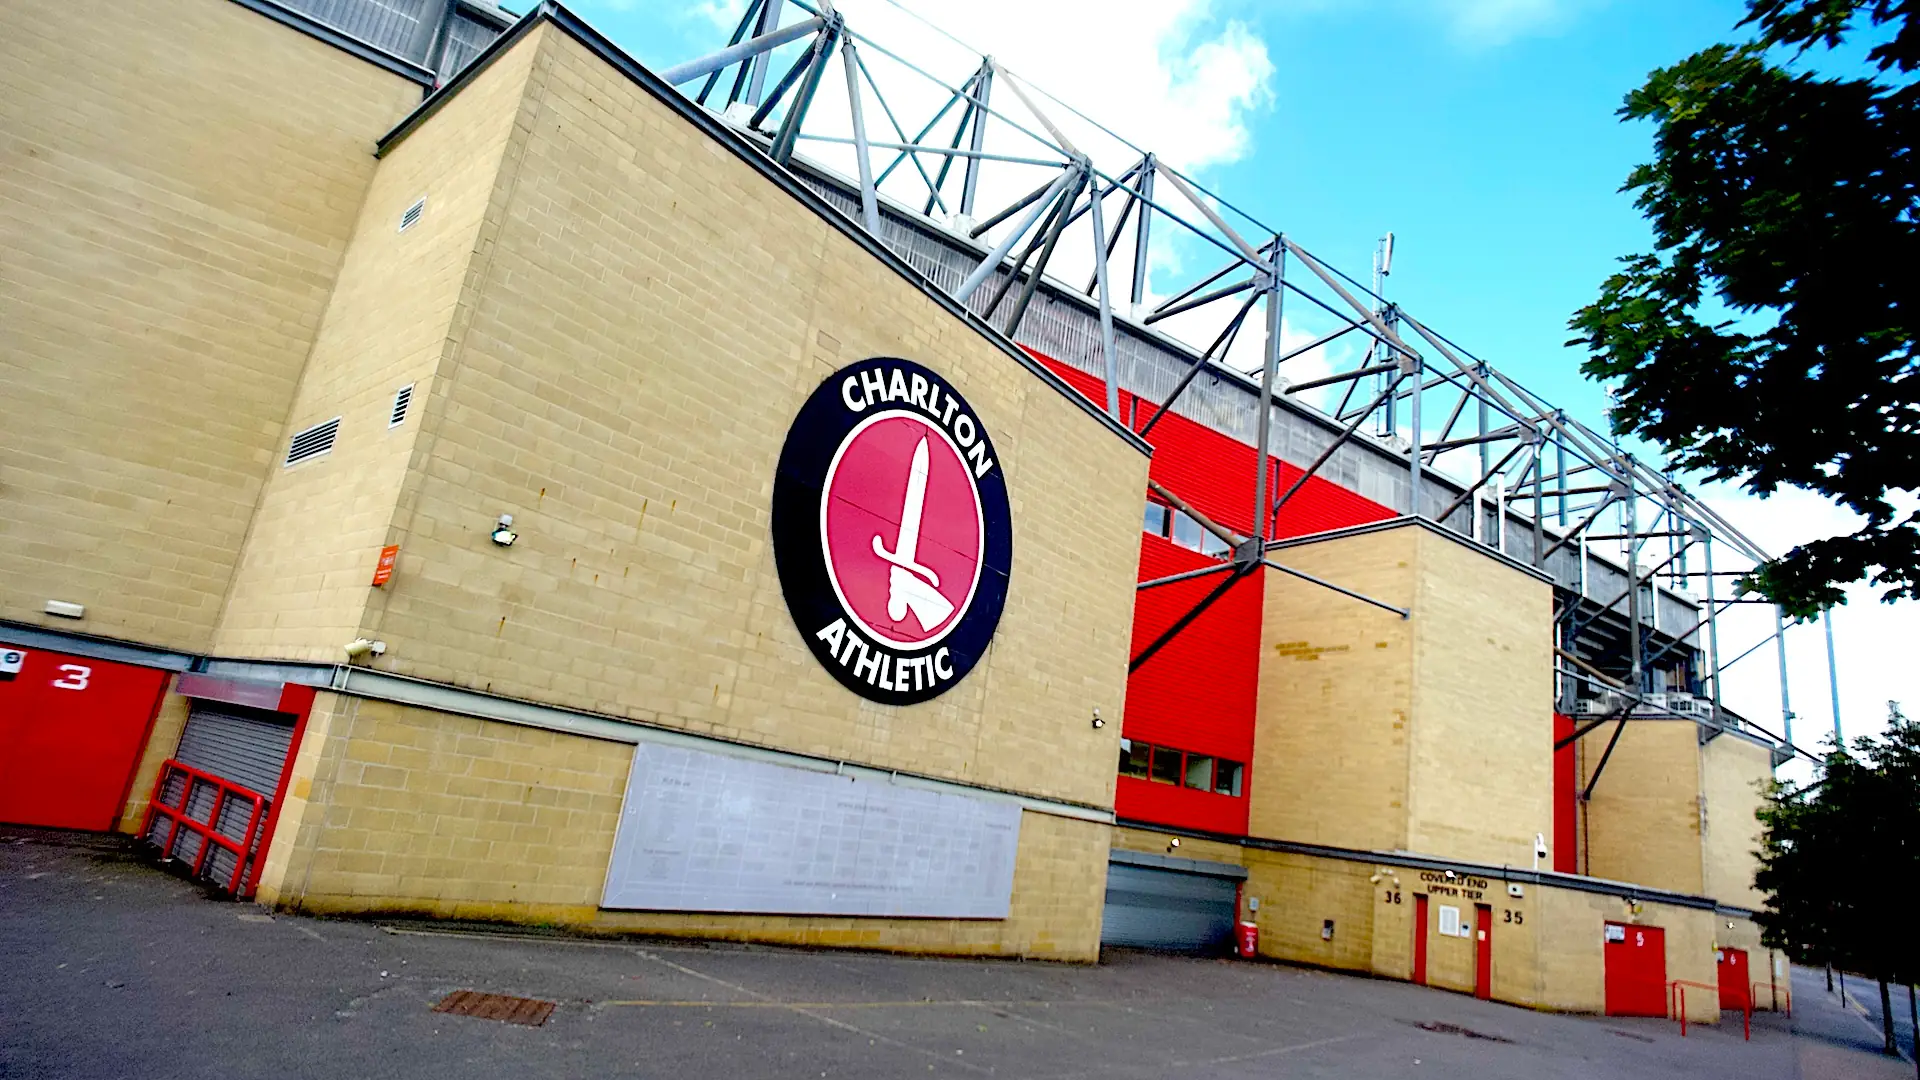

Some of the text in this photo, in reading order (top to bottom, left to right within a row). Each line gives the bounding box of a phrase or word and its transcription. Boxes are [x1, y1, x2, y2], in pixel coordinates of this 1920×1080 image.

[841, 367, 994, 480] CHARLTON
[815, 617, 954, 693] ATHLETIC
[53, 663, 92, 691] 3
[1468, 877, 1488, 889] END
[1385, 891, 1401, 904] 36
[1427, 884, 1483, 900] UPPER TIER
[1504, 909, 1523, 924] 35
[1636, 932, 1644, 946] 5
